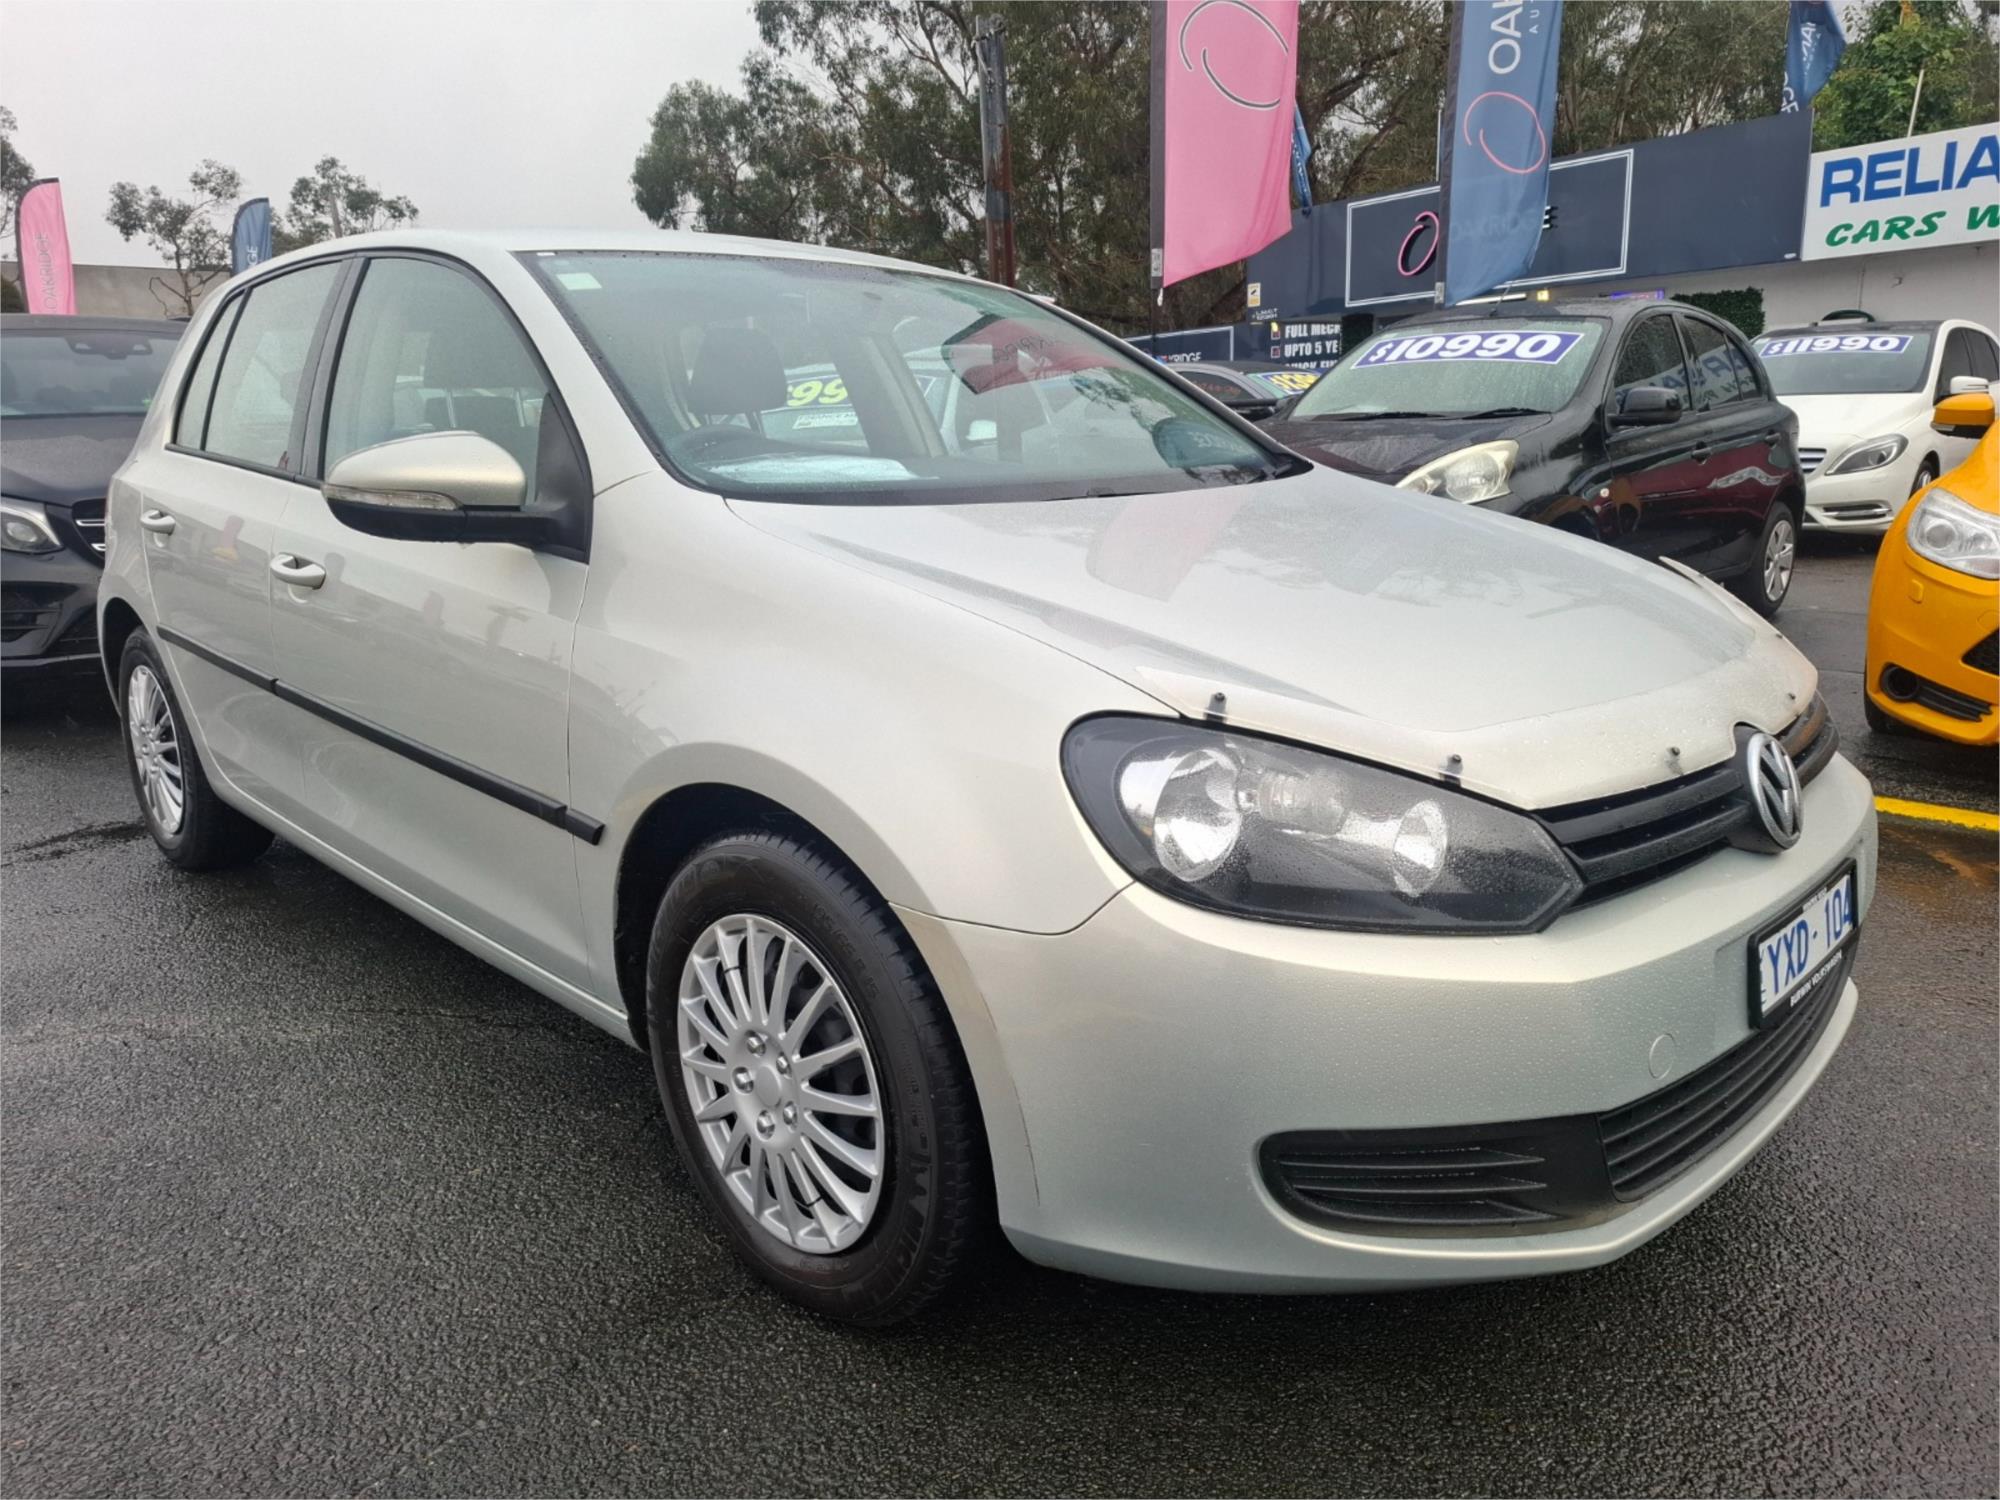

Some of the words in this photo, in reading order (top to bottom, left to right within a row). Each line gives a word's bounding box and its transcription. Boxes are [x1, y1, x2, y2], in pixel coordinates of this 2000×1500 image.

[1529, 0, 1540, 34] AU
[1825, 211, 1947, 247] CARS
[1285, 324, 1308, 338] FULL
[1284, 342, 1312, 358] UPTO
[1315, 341, 1322, 355] 5
[1369, 334, 1561, 362] $10990
[1769, 336, 1900, 354] $11990
